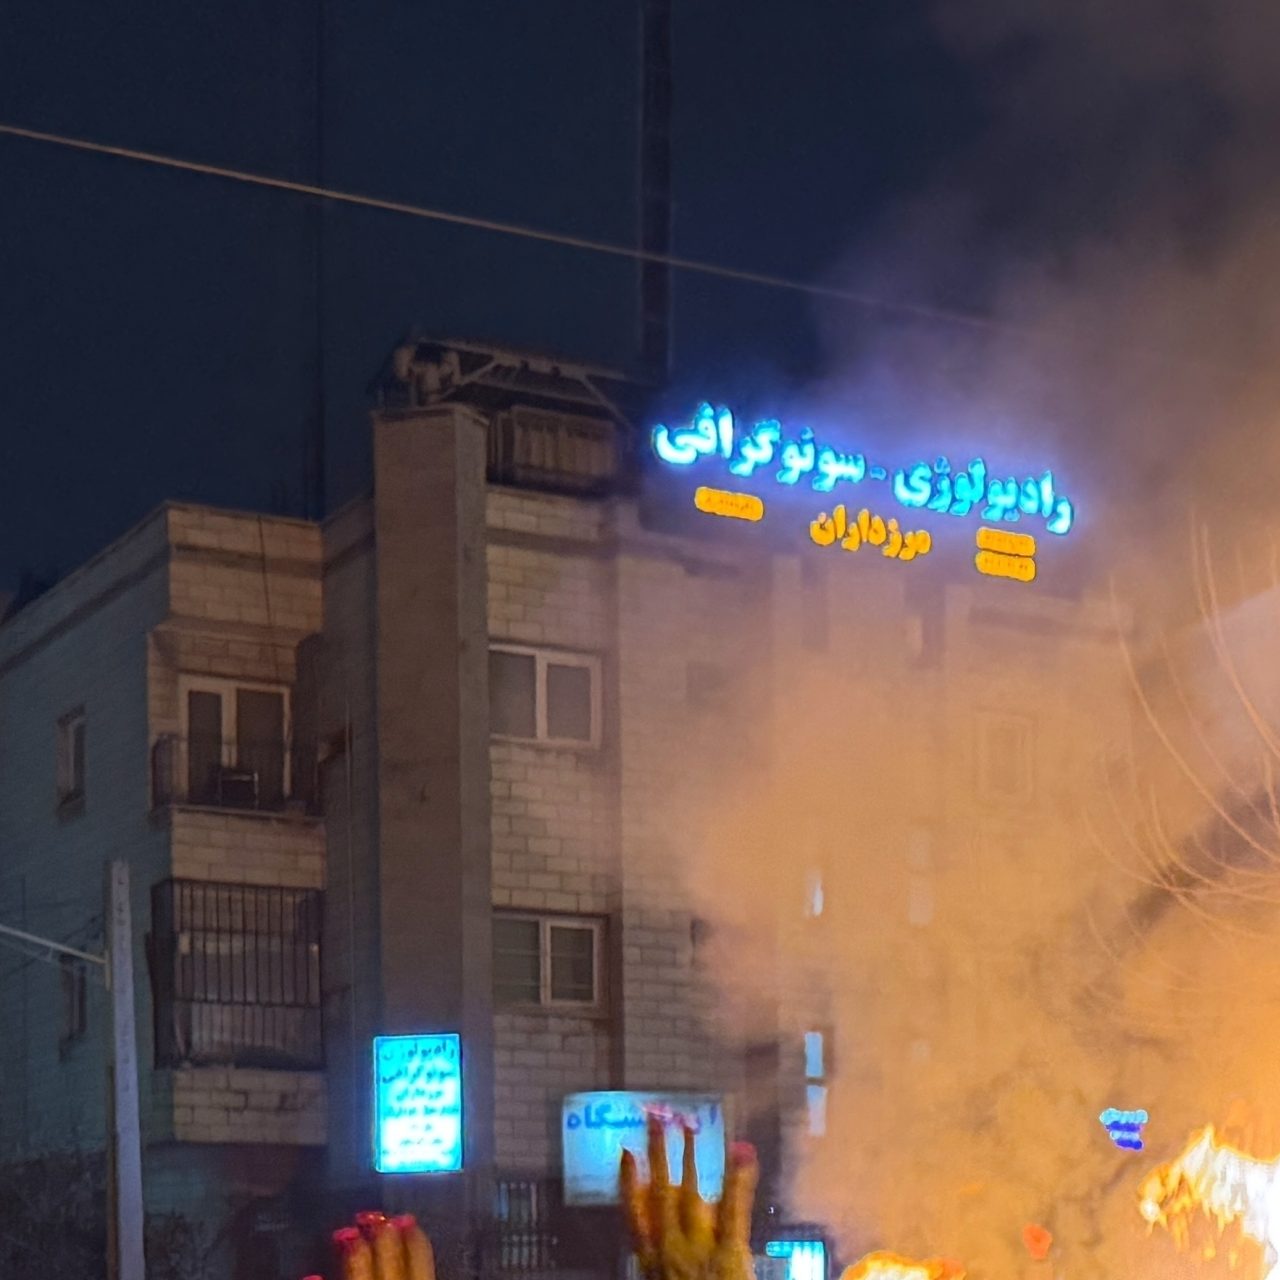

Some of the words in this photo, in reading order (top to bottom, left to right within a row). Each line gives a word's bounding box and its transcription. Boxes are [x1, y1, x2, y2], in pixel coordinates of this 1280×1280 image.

[652, 401, 866, 493] سونوگرافی
[809, 504, 932, 561] مرزداران
[894, 456, 1074, 535] رادیولوژی
